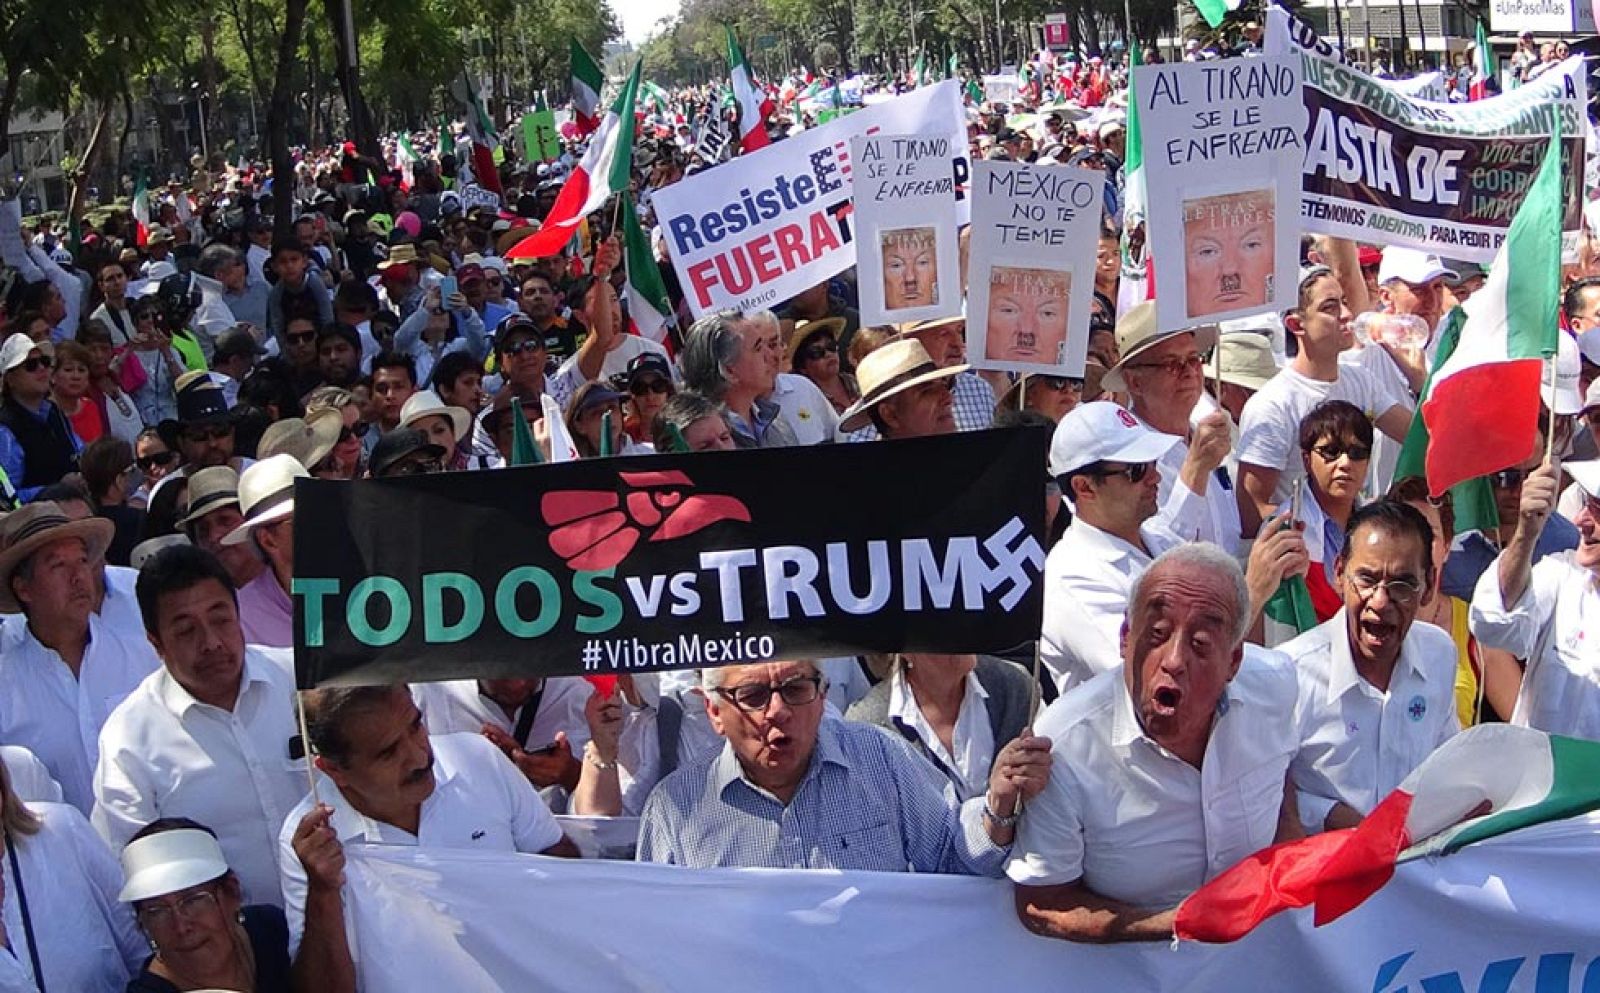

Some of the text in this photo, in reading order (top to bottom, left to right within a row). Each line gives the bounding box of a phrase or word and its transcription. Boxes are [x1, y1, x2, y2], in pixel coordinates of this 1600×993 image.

[1149, 63, 1295, 110] AL TIRANO
[1191, 105, 1263, 130] SE LE
[861, 138, 948, 163] AL TIRANO
[1166, 126, 1301, 166] ENFRENTA
[1302, 103, 1401, 198] ASTA
[1406, 145, 1466, 205] DE
[866, 162, 917, 179] SE LE
[874, 178, 953, 201] ENFRENTA
[988, 167, 1094, 208] MÉXICO
[1012, 203, 1076, 222] NO TE
[995, 223, 1066, 246] TEME
[1429, 225, 1459, 244] PARA
[1459, 230, 1490, 249] PEDIR
[291, 565, 624, 647] TODOS
[582, 631, 775, 672] #VibraMexico
